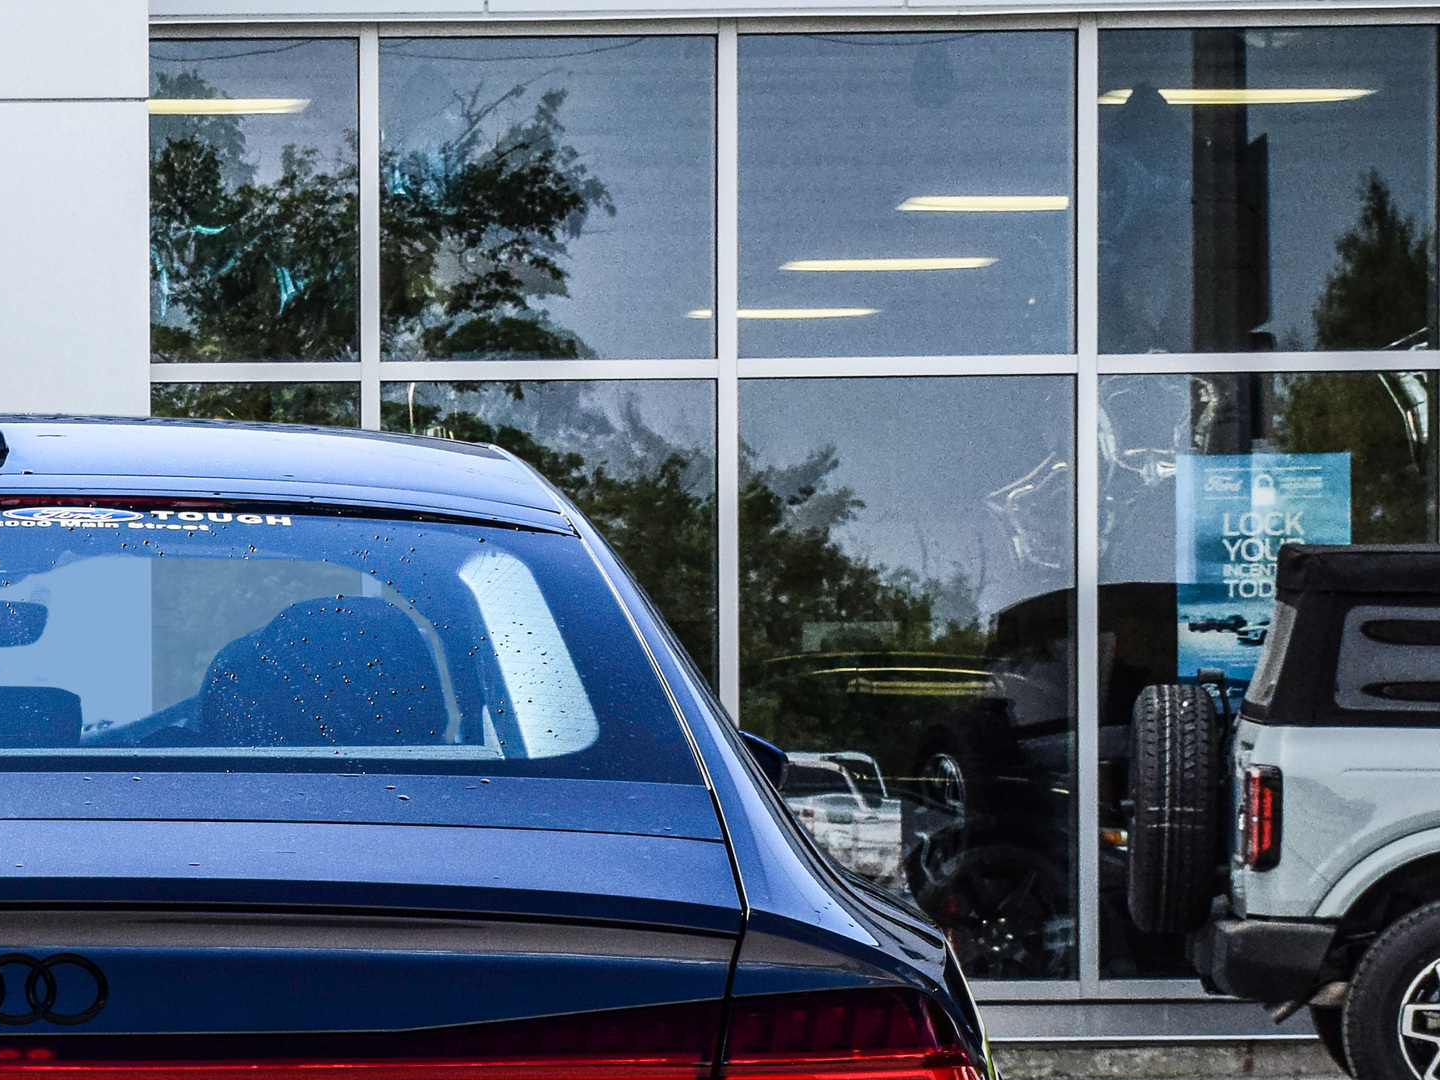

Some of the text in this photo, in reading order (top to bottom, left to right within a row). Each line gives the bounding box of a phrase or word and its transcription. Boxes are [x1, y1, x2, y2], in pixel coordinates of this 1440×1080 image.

[32, 508, 115, 520] Ford
[150, 510, 293, 527] TOUGH
[59, 519, 120, 528] Main
[127, 521, 210, 531] Street
[1222, 511, 1305, 537] LOCK
[1222, 537, 1305, 562] YOU
[1223, 563, 1278, 577] INCENT
[1223, 578, 1277, 599] TOD
